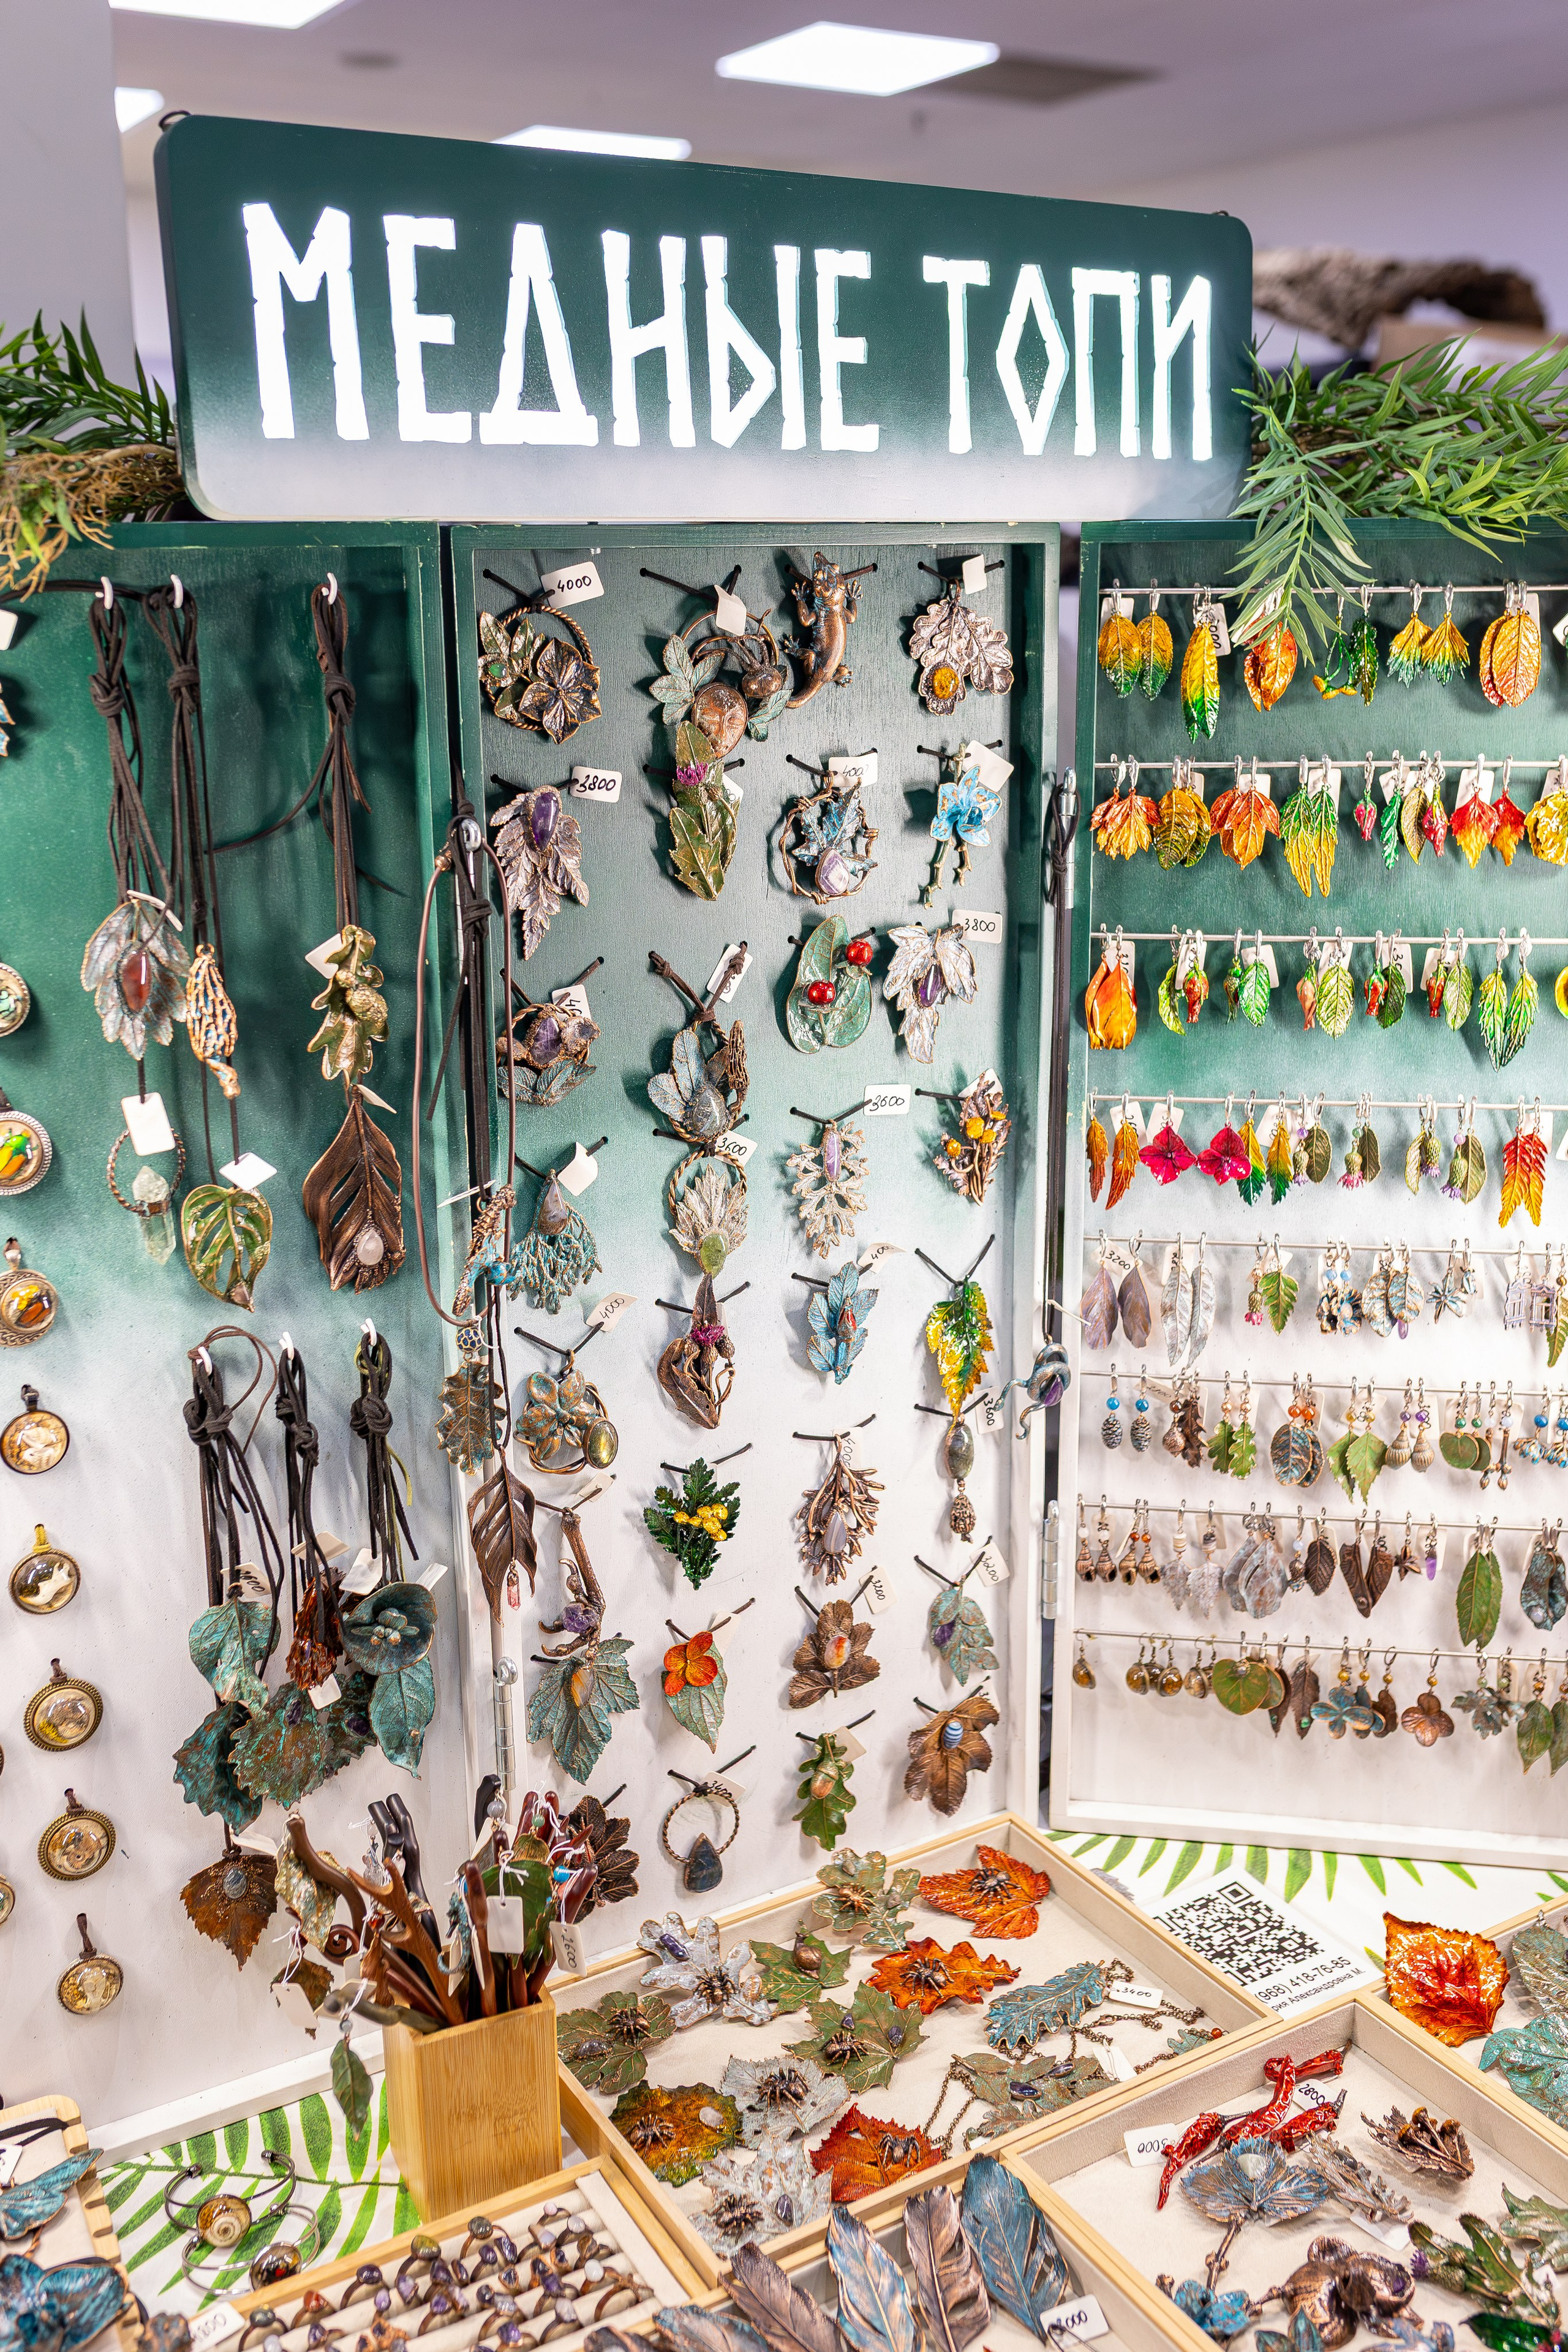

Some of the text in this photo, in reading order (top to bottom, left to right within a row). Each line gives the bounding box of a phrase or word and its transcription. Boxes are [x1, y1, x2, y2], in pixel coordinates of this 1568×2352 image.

[242, 202, 1213, 461] МЕДНЫЕ ТОПИ
[556, 575, 592, 592] 4000
[576, 774, 616, 793] 3800
[964, 918, 996, 932] 3800
[869, 1095, 905, 1112] 3600
[717, 1137, 747, 1156] 3600
[1105, 1249, 1131, 1270] 3200
[600, 1297, 625, 1319] 4000
[1254, 1956, 1351, 2004] (968) 418-76-85
[1291, 1973, 1354, 2004] Александровна
[1120, 1986, 1152, 1997] 3400
